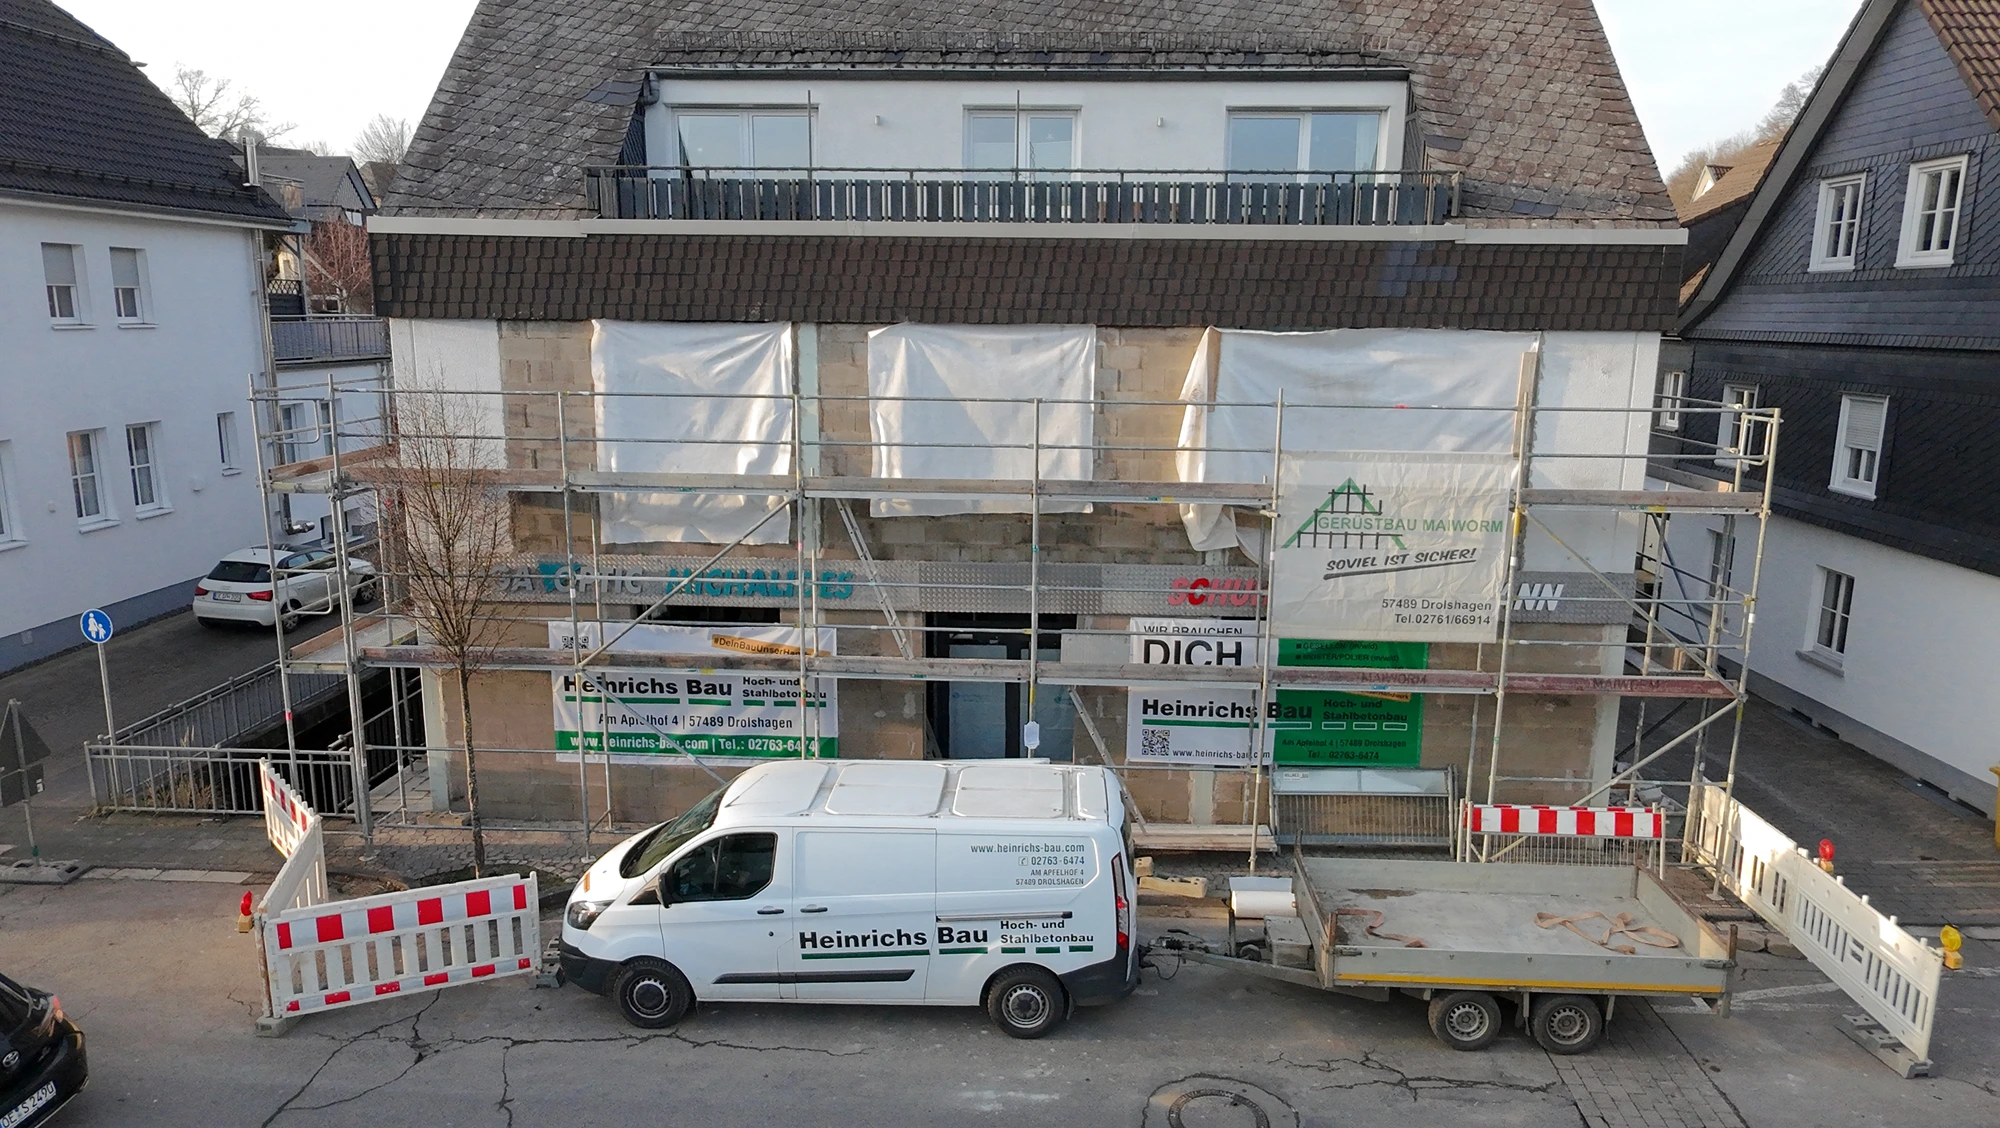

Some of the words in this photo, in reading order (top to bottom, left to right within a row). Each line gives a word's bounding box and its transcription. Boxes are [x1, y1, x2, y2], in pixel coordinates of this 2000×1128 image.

[1318, 515, 1417, 531] GERÜSTBAU
[1422, 518, 1503, 533] MAIWORM
[1326, 556, 1377, 571] SOVIEL
[1384, 553, 1410, 566] IST
[1414, 548, 1477, 563] SICHER!
[1501, 582, 1564, 611] NN
[1381, 598, 1417, 610] 57489
[1421, 599, 1492, 612] Drolshagen
[1394, 613, 1490, 625] Tel.02761/66914
[1143, 625, 1168, 634] WIR
[1172, 626, 1243, 635] BRAUCHEN
[1143, 639, 1242, 666] DICH
[563, 675, 678, 694] Heinrichs
[686, 679, 732, 696] Bau
[742, 676, 776, 686] Hoch-
[779, 677, 802, 687] und
[1142, 699, 1258, 719] Heinrichs
[1267, 701, 1312, 719] Bau
[1323, 699, 1357, 709] Hoch-
[1360, 699, 1383, 709] und
[598, 713, 617, 725] Am
[671, 715, 679, 725] 4
[689, 715, 724, 727] 57489
[727, 716, 793, 730] Drolshagen
[1323, 711, 1408, 721] Stahlbetonbau
[570, 735, 709, 749] www.einrichs-ba.com
[748, 738, 818, 752] 02763-644
[1296, 739, 1327, 748] Apfelhof
[1340, 739, 1363, 747] 57489
[1364, 739, 1407, 748] Drolshagen
[1172, 749, 1270, 759] www.heinrichs-ba.cm
[1328, 751, 1379, 759] 02763-6474
[970, 843, 1085, 853] www.heinrichs-bau.com
[1031, 856, 1085, 866] 02763-6474
[1037, 877, 1084, 886] DROLSHAGEN
[1000, 920, 1037, 930] Hoch-
[1042, 920, 1065, 929] und
[799, 925, 928, 950] Heinrichs
[938, 926, 988, 944] Bau
[1000, 933, 1094, 944] Stahlbetonbau
[2, 1111, 17, 1128] OE
[21, 1101, 30, 1114] S
